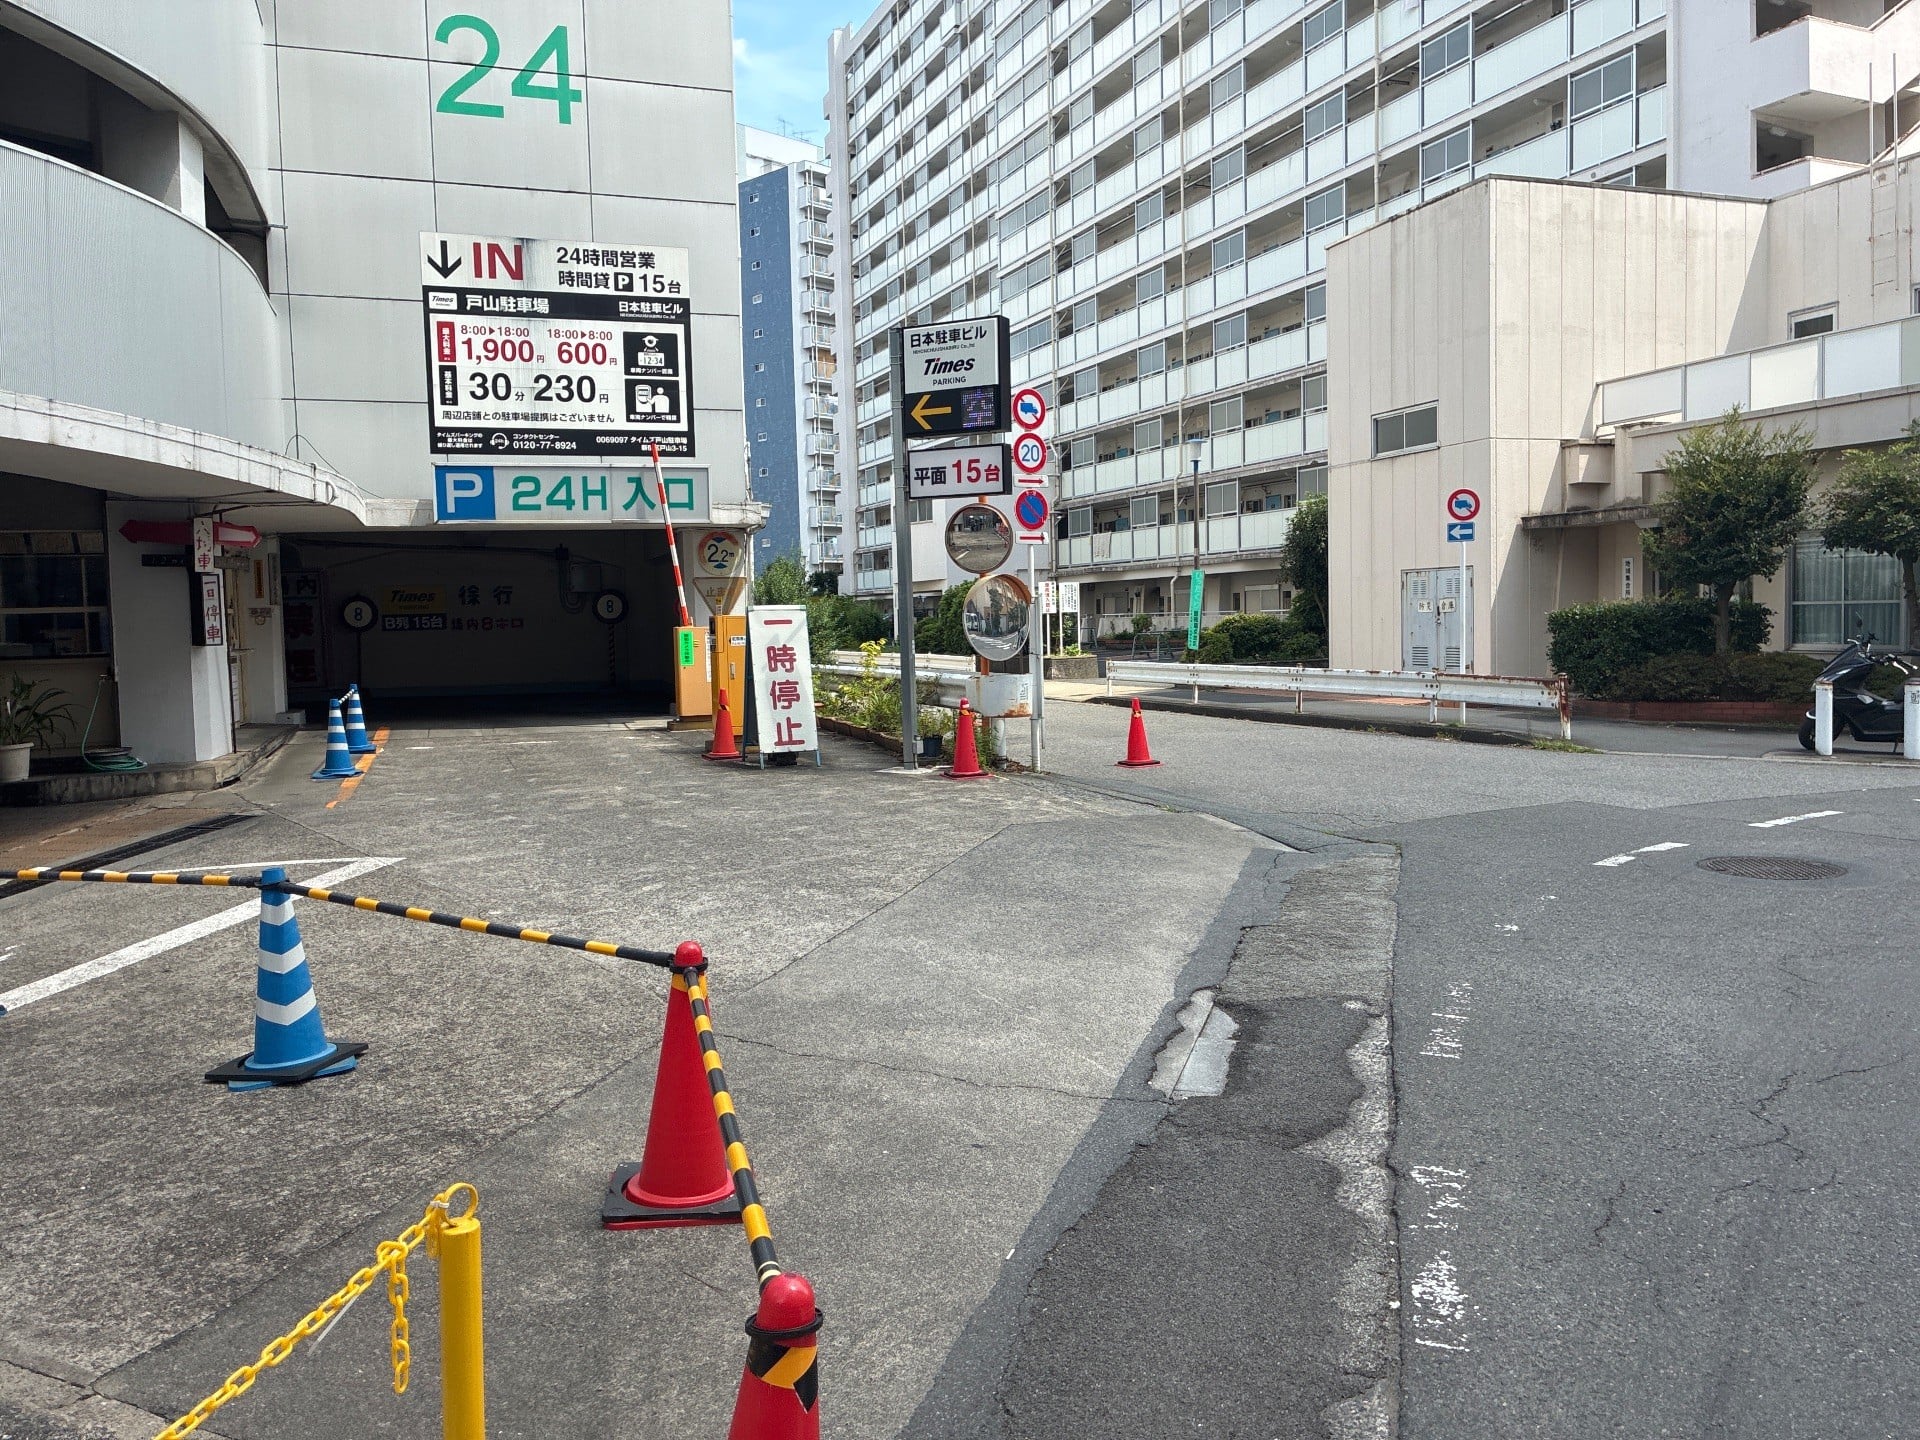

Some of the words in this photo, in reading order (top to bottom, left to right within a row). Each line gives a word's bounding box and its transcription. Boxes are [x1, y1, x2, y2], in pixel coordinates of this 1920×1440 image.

[435, 14, 582, 125] 24
[472, 242, 524, 281] IN
[556, 247, 656, 269] 24時間営業
[558, 271, 610, 290] 時間貸
[638, 275, 682, 294] 15台
[432, 295, 454, 303] Times
[465, 294, 550, 314] 戸山駐車場
[618, 301, 683, 314] 日本駐車ビル
[460, 324, 487, 335] 8:00
[497, 326, 530, 337] 18:00
[547, 328, 579, 339] 18:00
[588, 330, 613, 340] 8:00
[910, 326, 987, 347] 日本駐車ビル
[461, 337, 545, 365] 1,900円
[557, 341, 618, 366] 600円
[923, 357, 976, 376] Times
[469, 372, 525, 401] 30分
[533, 374, 609, 404] 230円
[933, 376, 967, 386] PARKING
[442, 410, 615, 423] 周辺店舗との駐車場提携はございません
[512, 440, 577, 450] 0120-77-8924
[596, 436, 629, 444] 0069097
[1021, 444, 1040, 462] 20
[913, 466, 948, 486] 平面
[952, 458, 1000, 484] 15台
[445, 472, 484, 514] P
[511, 475, 606, 511] 24H
[622, 477, 694, 511] 入口
[391, 590, 436, 602] Times
[415, 616, 443, 628] 15台
[763, 618, 805, 747] 一時停止
